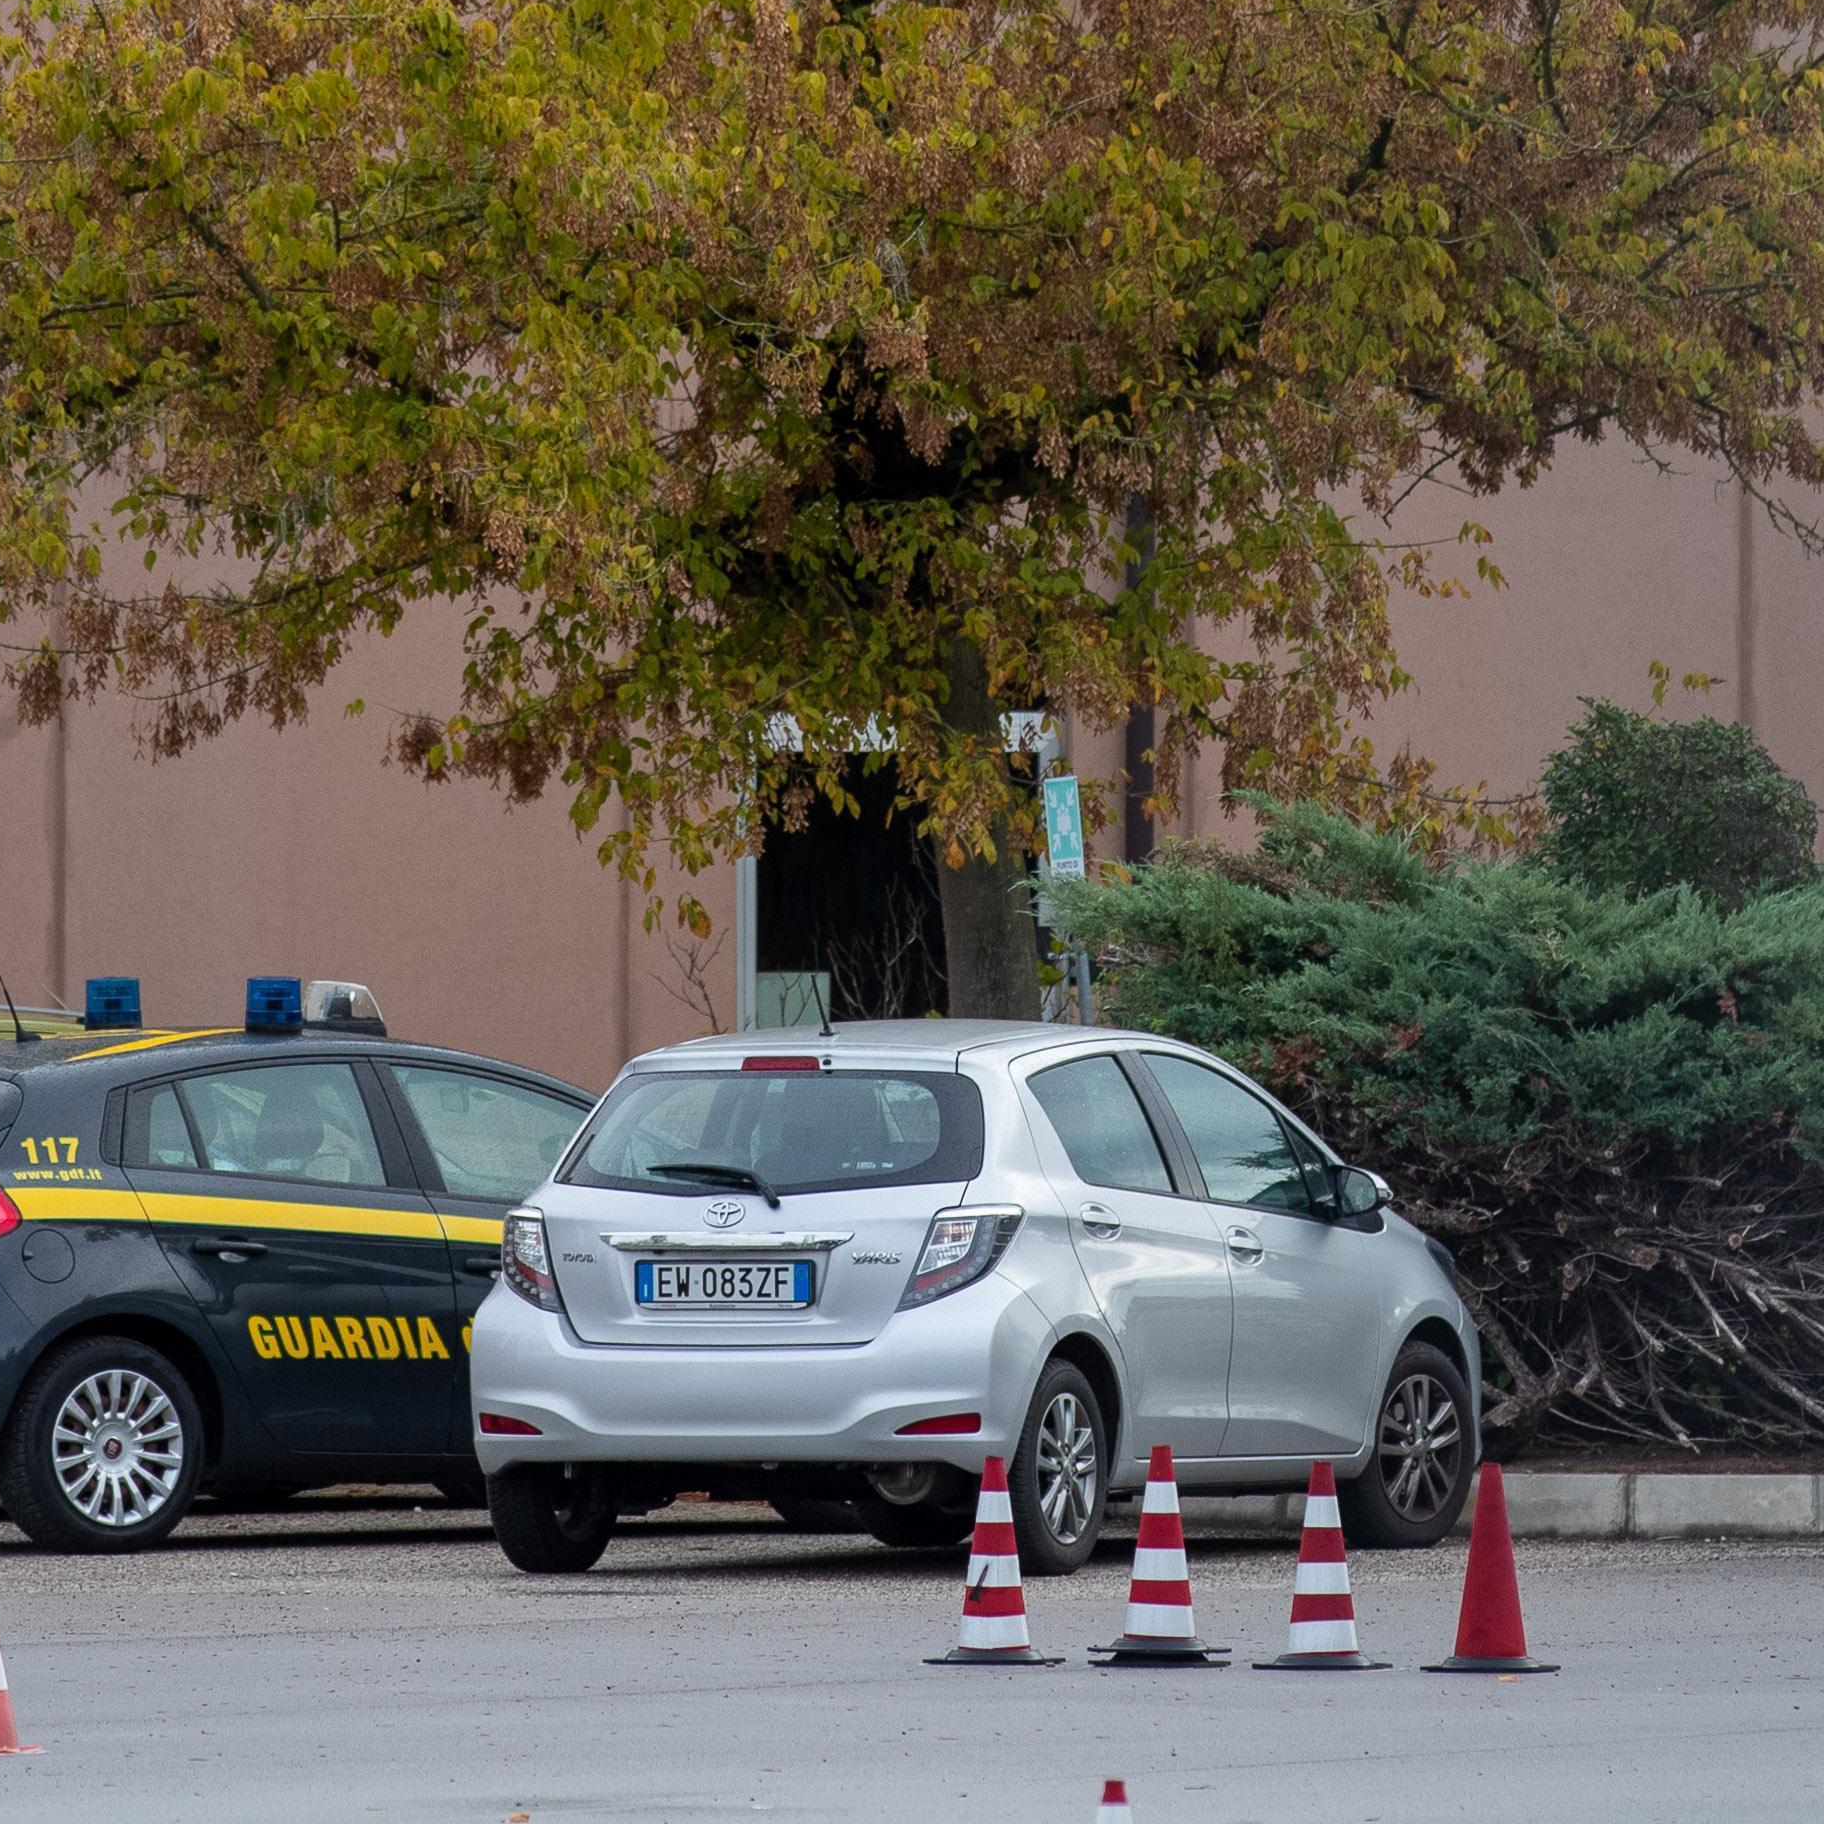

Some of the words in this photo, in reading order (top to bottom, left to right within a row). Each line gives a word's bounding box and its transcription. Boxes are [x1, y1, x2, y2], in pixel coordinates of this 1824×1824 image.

[20, 1137, 79, 1164] 117
[13, 1168, 103, 1181] www.gdf.it
[852, 1251, 902, 1265] YARIS
[248, 1315, 450, 1360] GUARDIA
